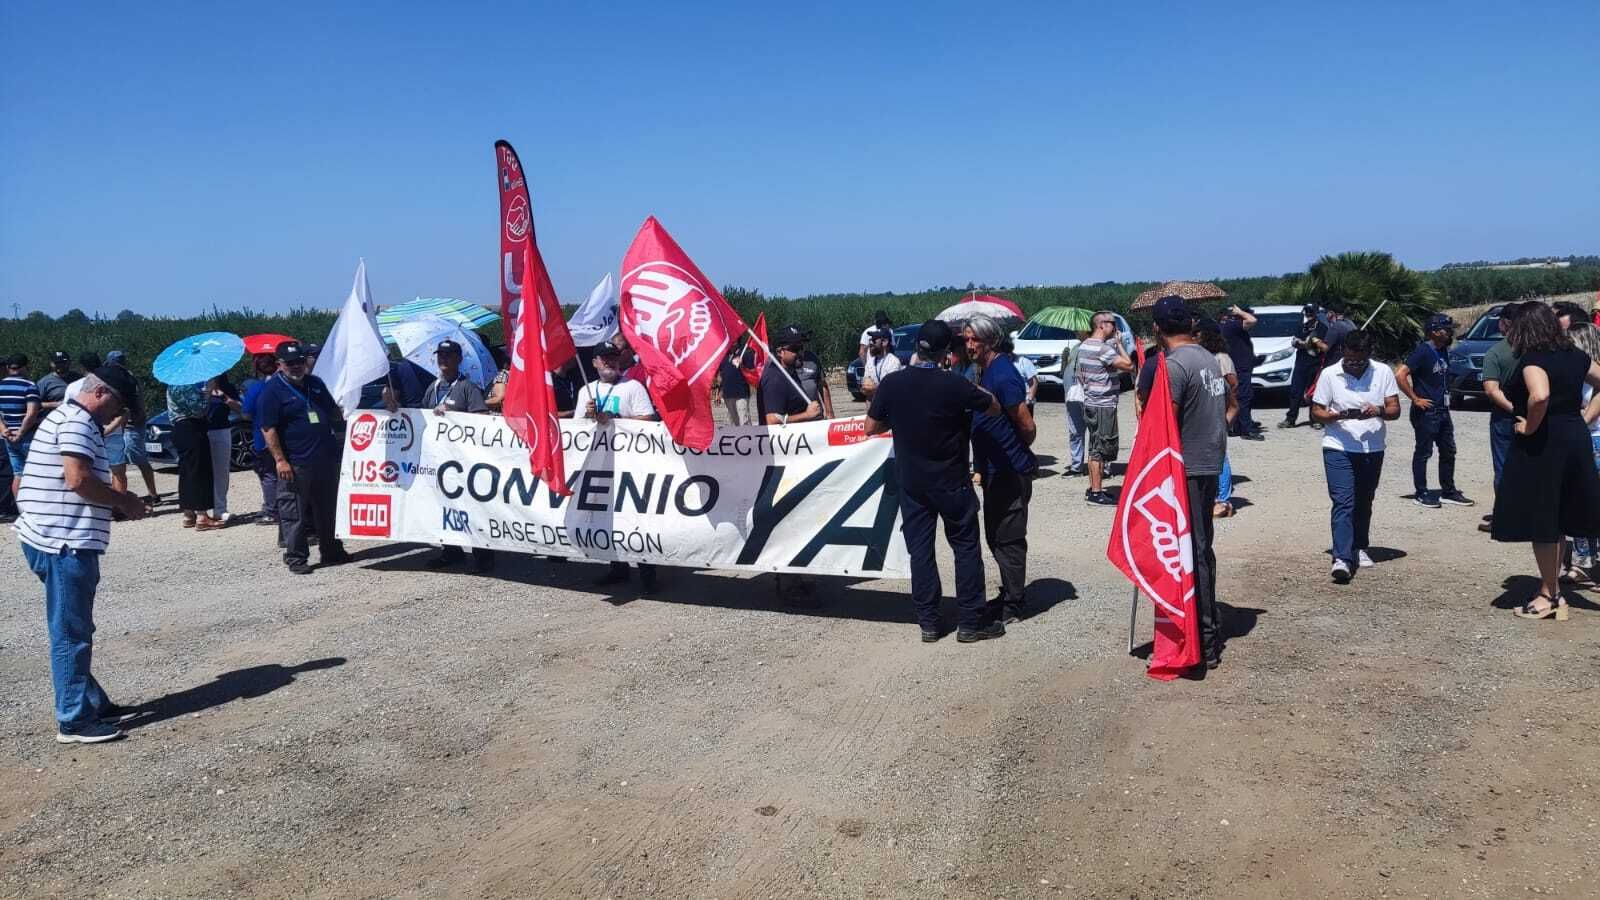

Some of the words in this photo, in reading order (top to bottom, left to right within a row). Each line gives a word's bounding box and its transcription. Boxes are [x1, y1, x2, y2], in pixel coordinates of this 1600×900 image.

[436, 422, 475, 446] POR
[482, 426, 504, 448] LA
[510, 428, 665, 454] NOCIACIÓN
[672, 433, 813, 456] CLECTIVA
[351, 503, 388, 527] CCOO
[442, 507, 473, 535] KBR
[490, 518, 538, 543] BASE
[543, 525, 569, 546] DE
[575, 527, 663, 554] MORÓN
[736, 457, 901, 571] YA
